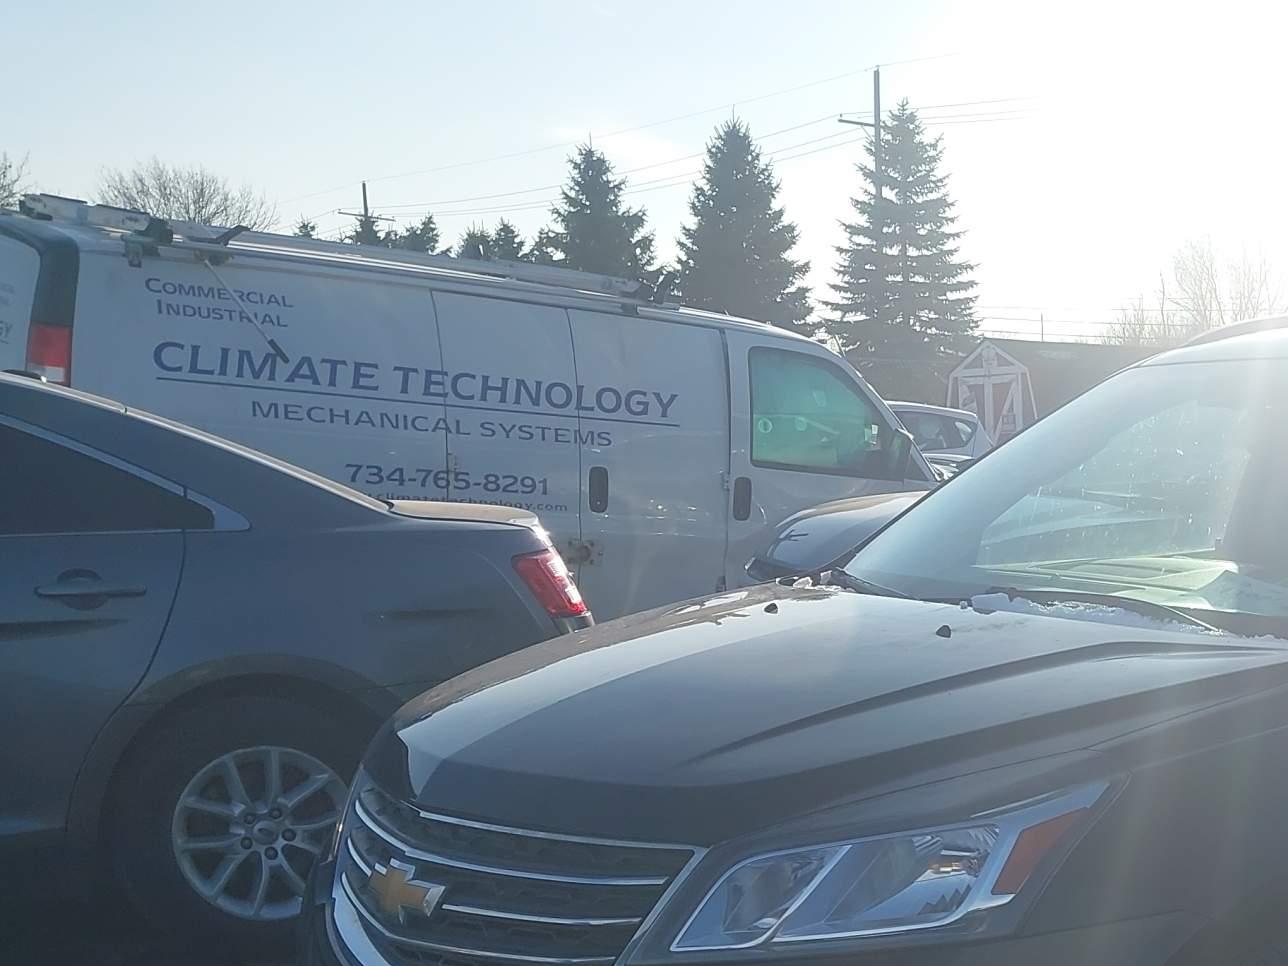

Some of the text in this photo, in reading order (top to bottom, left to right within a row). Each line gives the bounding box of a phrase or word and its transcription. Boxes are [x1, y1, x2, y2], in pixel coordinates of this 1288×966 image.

[145, 278, 295, 308] COMMERCIAL
[156, 299, 289, 328] INDUSTRIAL
[153, 341, 679, 418] CLIMATE TECHNOLOGY
[251, 400, 612, 447] MECHANICAL SYSTEMS
[345, 463, 549, 496] 734-765-8291
